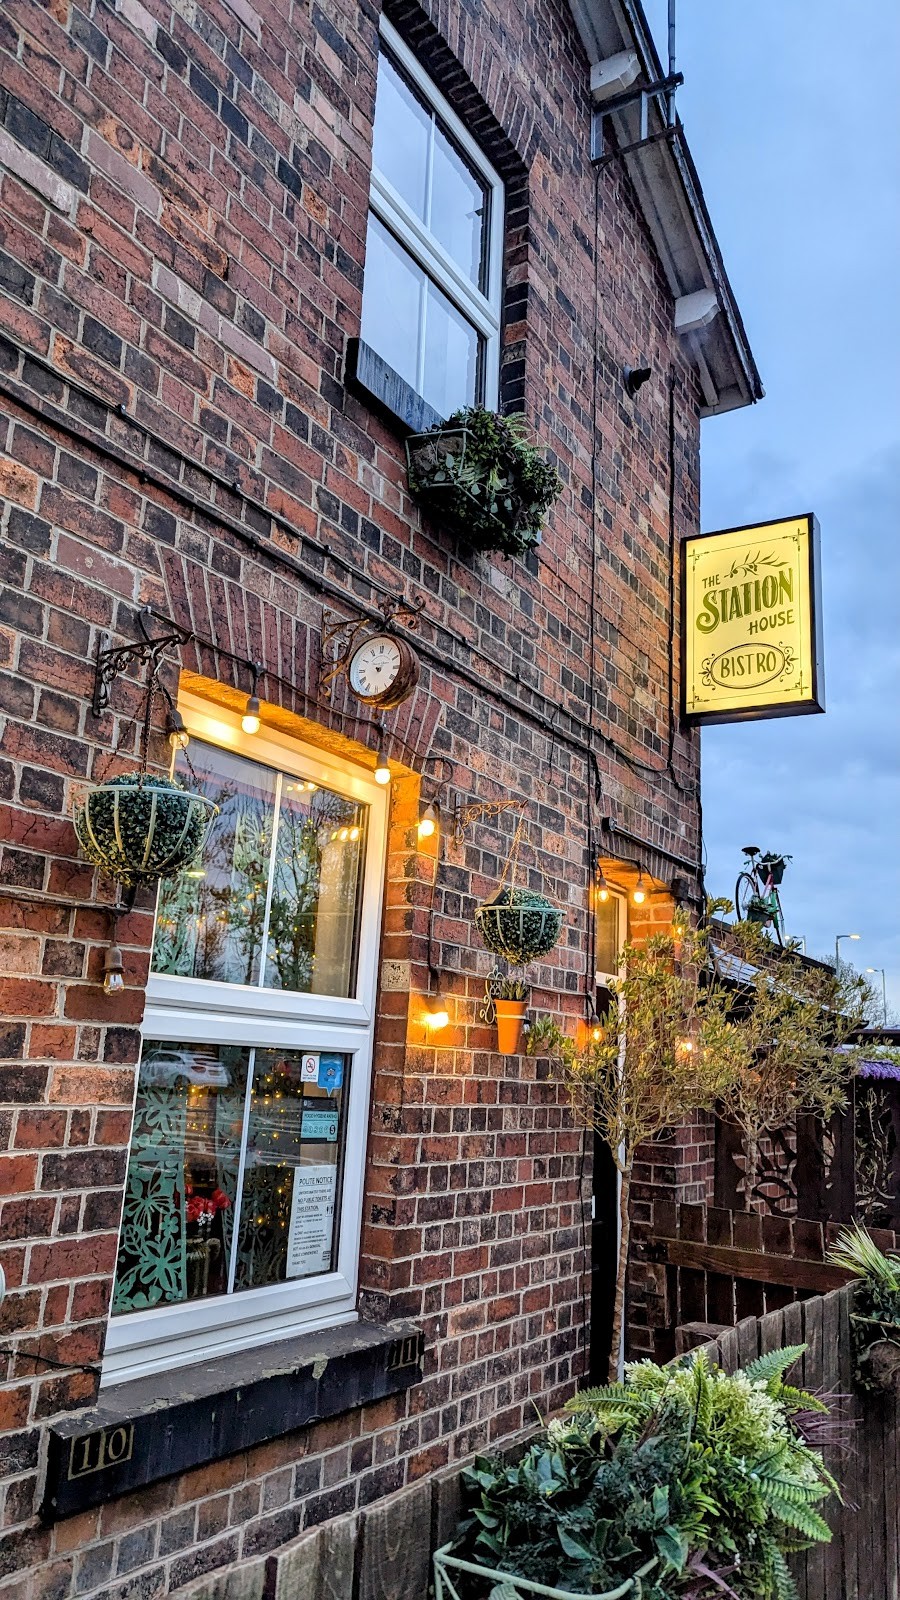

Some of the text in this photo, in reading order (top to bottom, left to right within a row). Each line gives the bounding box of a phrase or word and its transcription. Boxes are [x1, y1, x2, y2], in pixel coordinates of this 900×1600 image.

[702, 573, 721, 589] THE
[695, 567, 795, 635] STATION
[747, 608, 795, 635] HOUSE
[720, 651, 777, 679] BISTRO
[299, 1176, 333, 1185] POLITE NOTICE
